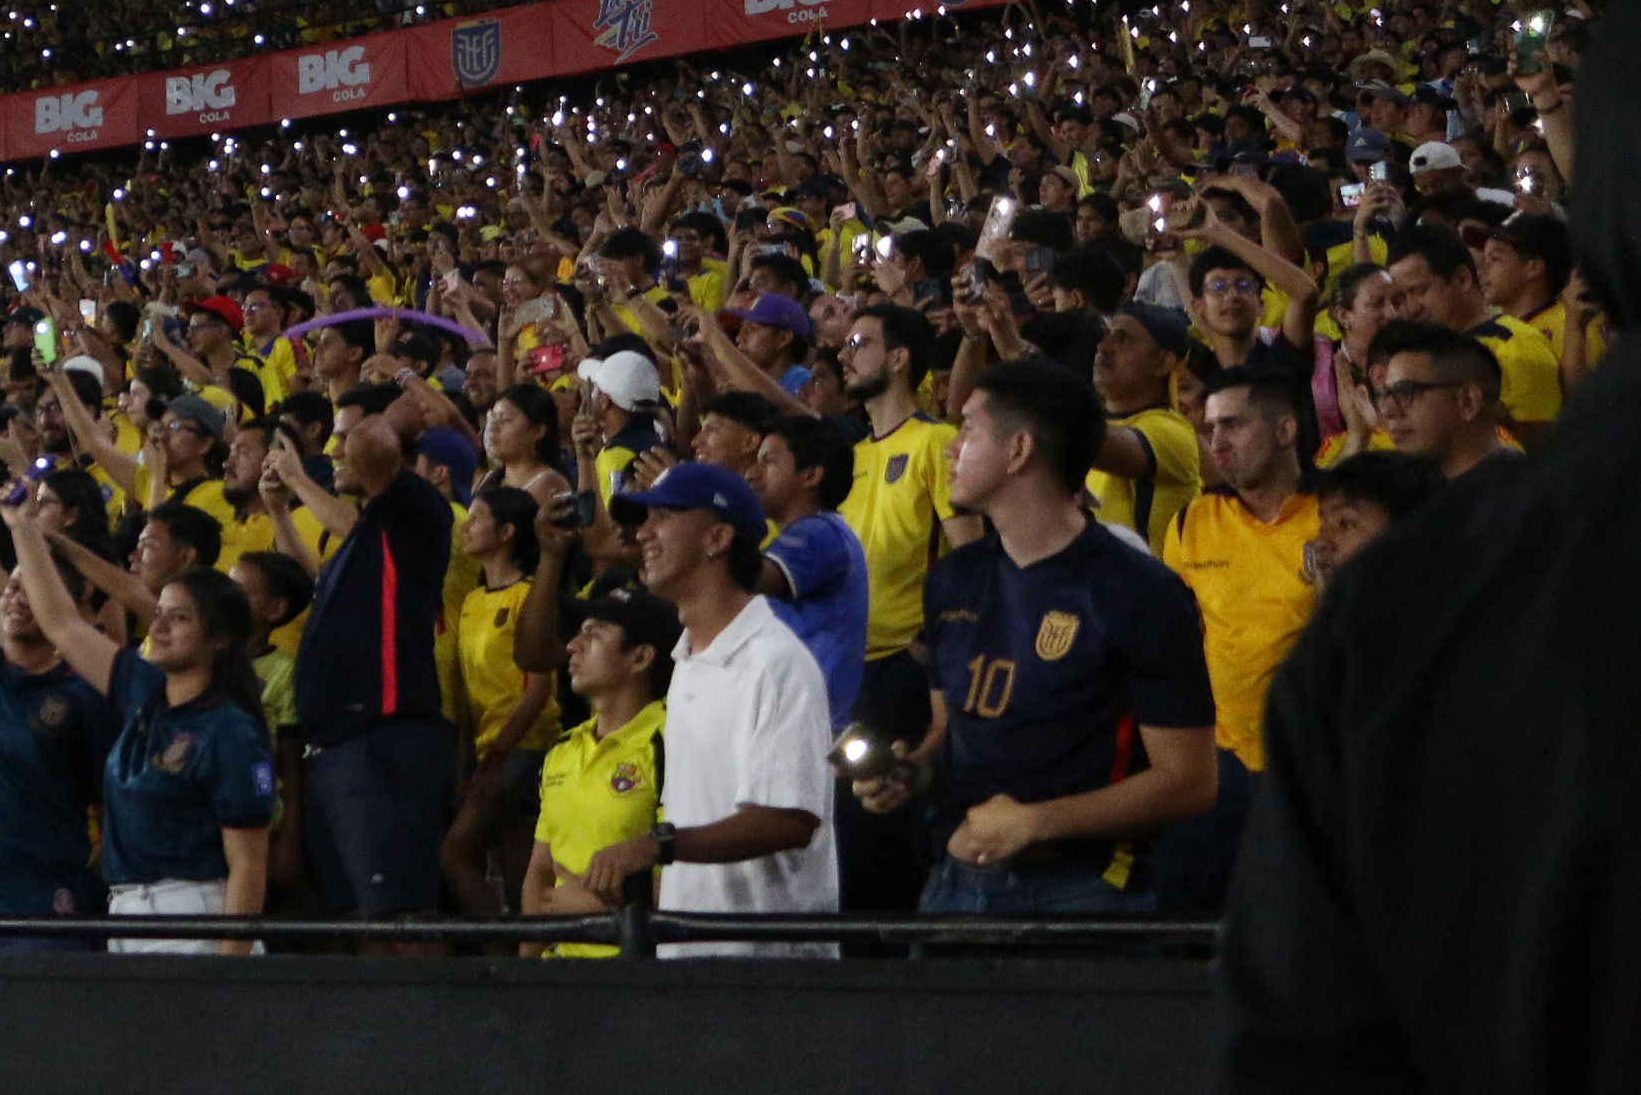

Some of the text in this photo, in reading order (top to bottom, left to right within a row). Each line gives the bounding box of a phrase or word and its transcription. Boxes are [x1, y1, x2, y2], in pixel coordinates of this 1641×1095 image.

[787, 6, 828, 24] COLA
[298, 46, 370, 94] BIG
[166, 70, 235, 115] BIG
[332, 87, 366, 102] COLA
[35, 90, 103, 134] BIG
[199, 110, 231, 124] COLA
[66, 129, 98, 143] COLA
[962, 653, 1018, 718] 10
